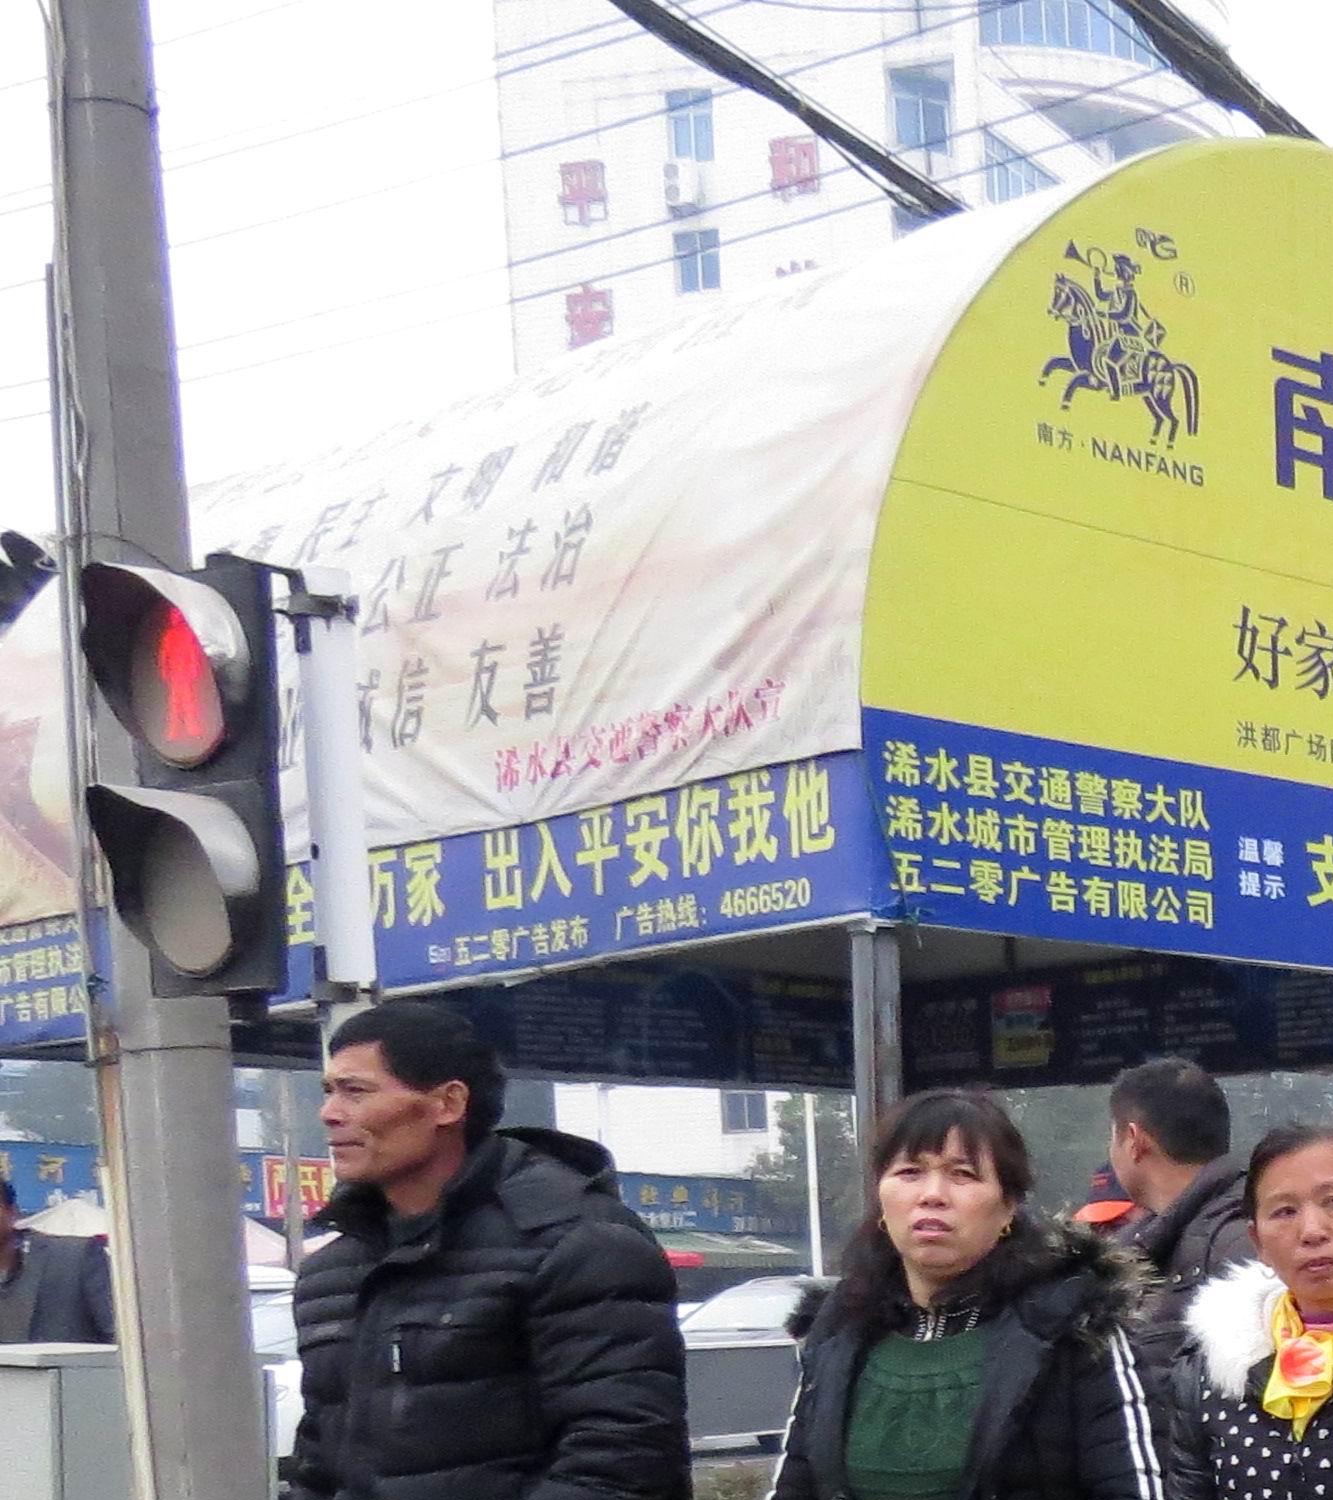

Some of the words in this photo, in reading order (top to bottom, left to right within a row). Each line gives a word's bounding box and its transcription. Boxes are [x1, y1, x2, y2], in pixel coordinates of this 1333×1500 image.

[1091, 435, 1205, 487] NANFANG
[487, 502, 593, 602] 法治
[466, 623, 566, 732] 友善
[883, 740, 1211, 832] 浠水县交通警察大队
[484, 763, 836, 912] 出入平安你我他
[886, 795, 1214, 882] 浠水城市管理执法局
[1237, 835, 1285, 869] 温馨
[890, 850, 1215, 930] 五二零广告有限公司
[1238, 870, 1287, 901] 提示
[453, 915, 590, 968] 五二零广告发布
